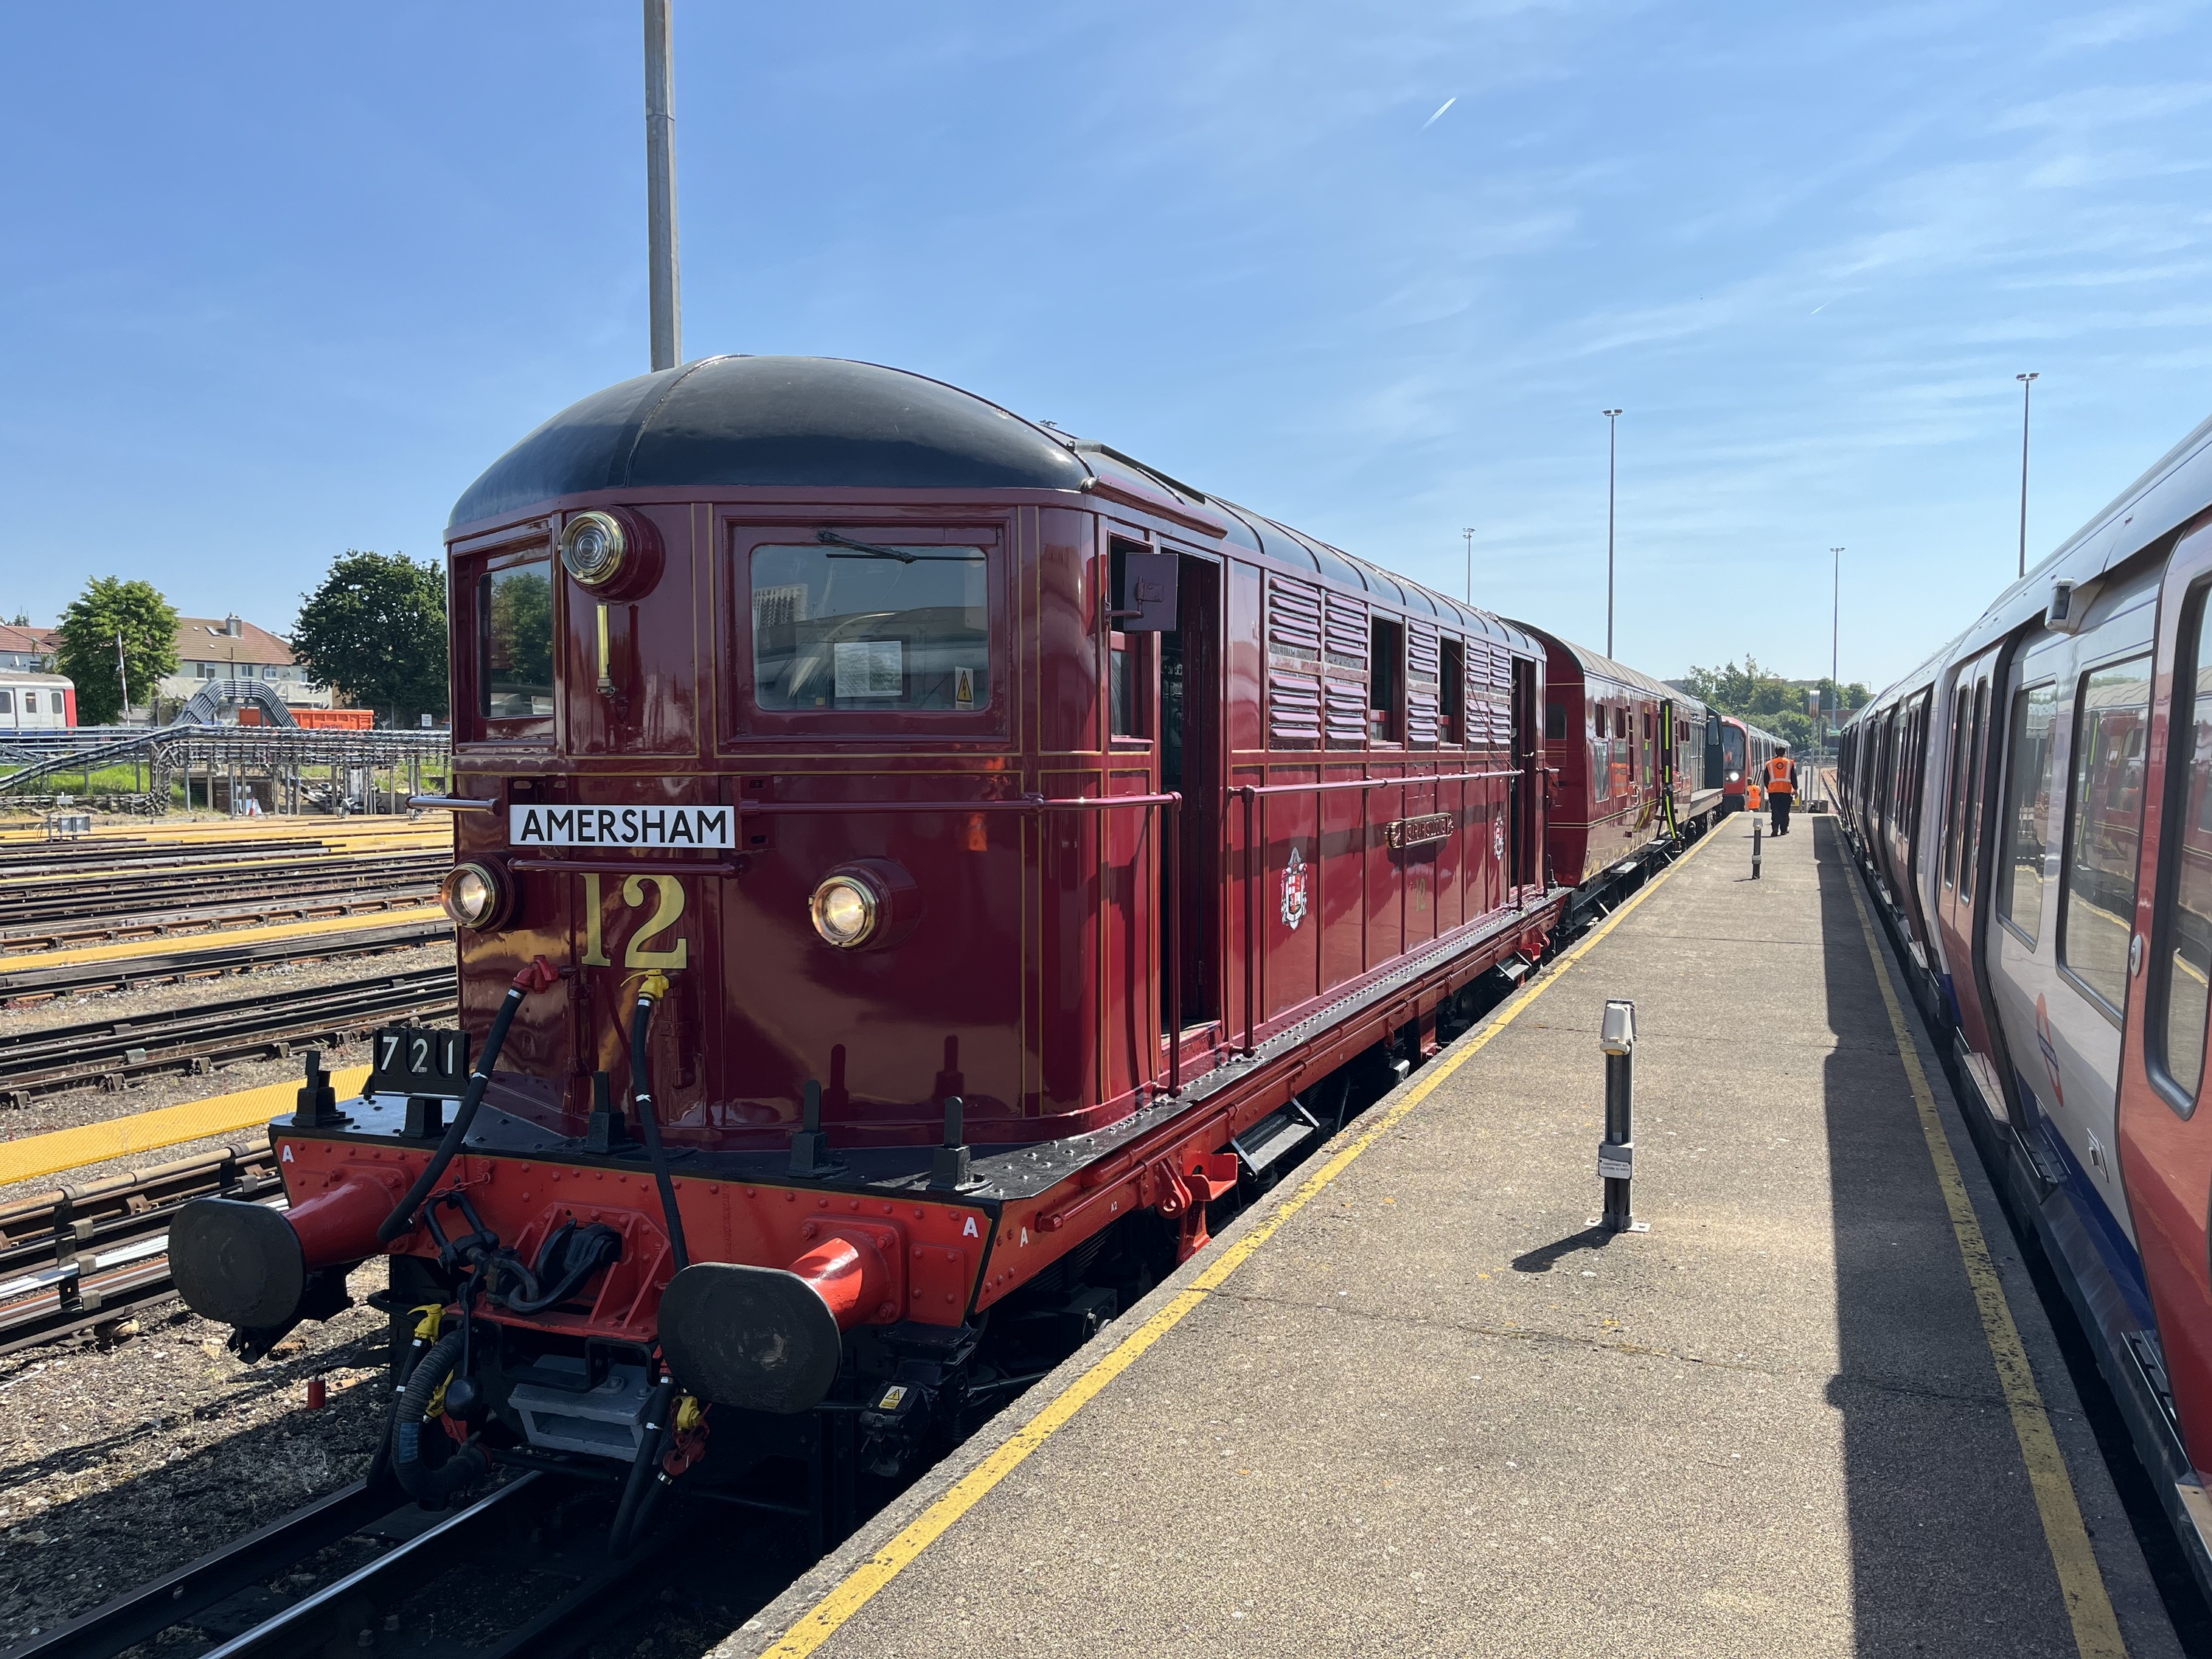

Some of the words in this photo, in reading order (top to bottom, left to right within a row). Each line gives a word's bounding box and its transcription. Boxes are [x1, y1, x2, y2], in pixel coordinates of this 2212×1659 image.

[521, 809, 726, 844] AMERSHAM
[1415, 877, 1426, 912] 12
[580, 873, 688, 970] 12
[381, 1035, 453, 1075] 721
[282, 1145, 294, 1163] A
[1110, 1200, 1118, 1213] A2
[962, 1217, 979, 1239] A
[1020, 1226, 1029, 1248] A
